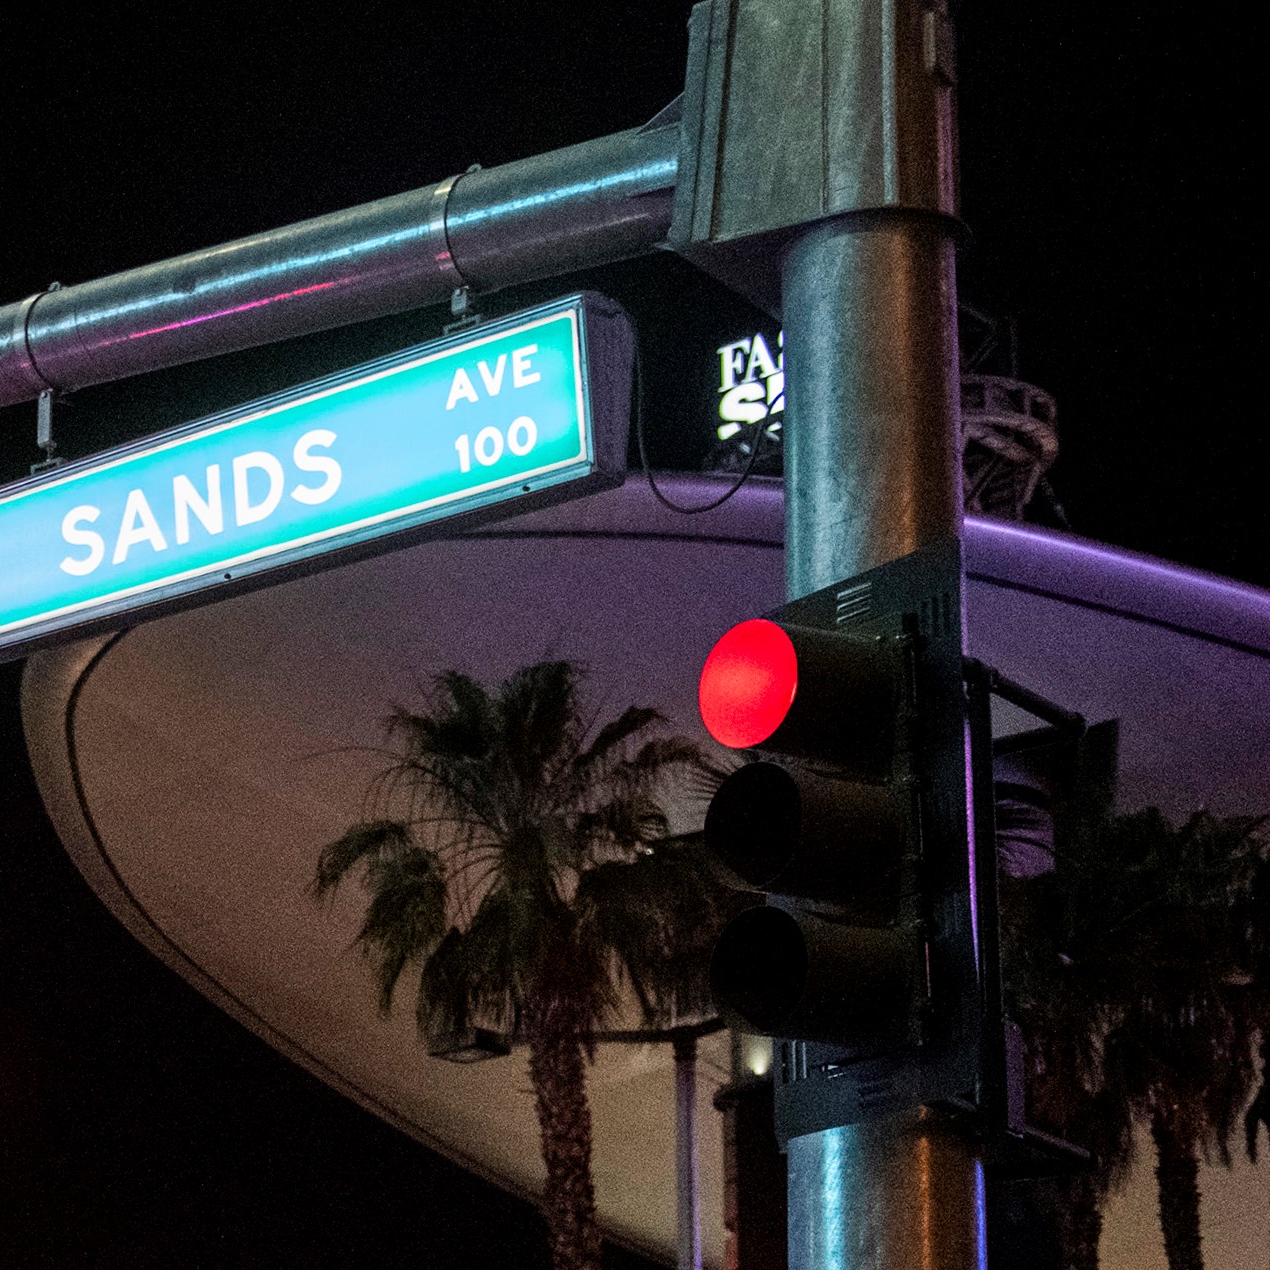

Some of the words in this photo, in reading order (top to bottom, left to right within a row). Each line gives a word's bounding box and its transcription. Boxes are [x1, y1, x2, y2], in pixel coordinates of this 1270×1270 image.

[717, 329, 784, 393] FA
[59, 429, 343, 577] SANDS
[444, 344, 542, 410] AVE
[454, 415, 540, 473] 100
